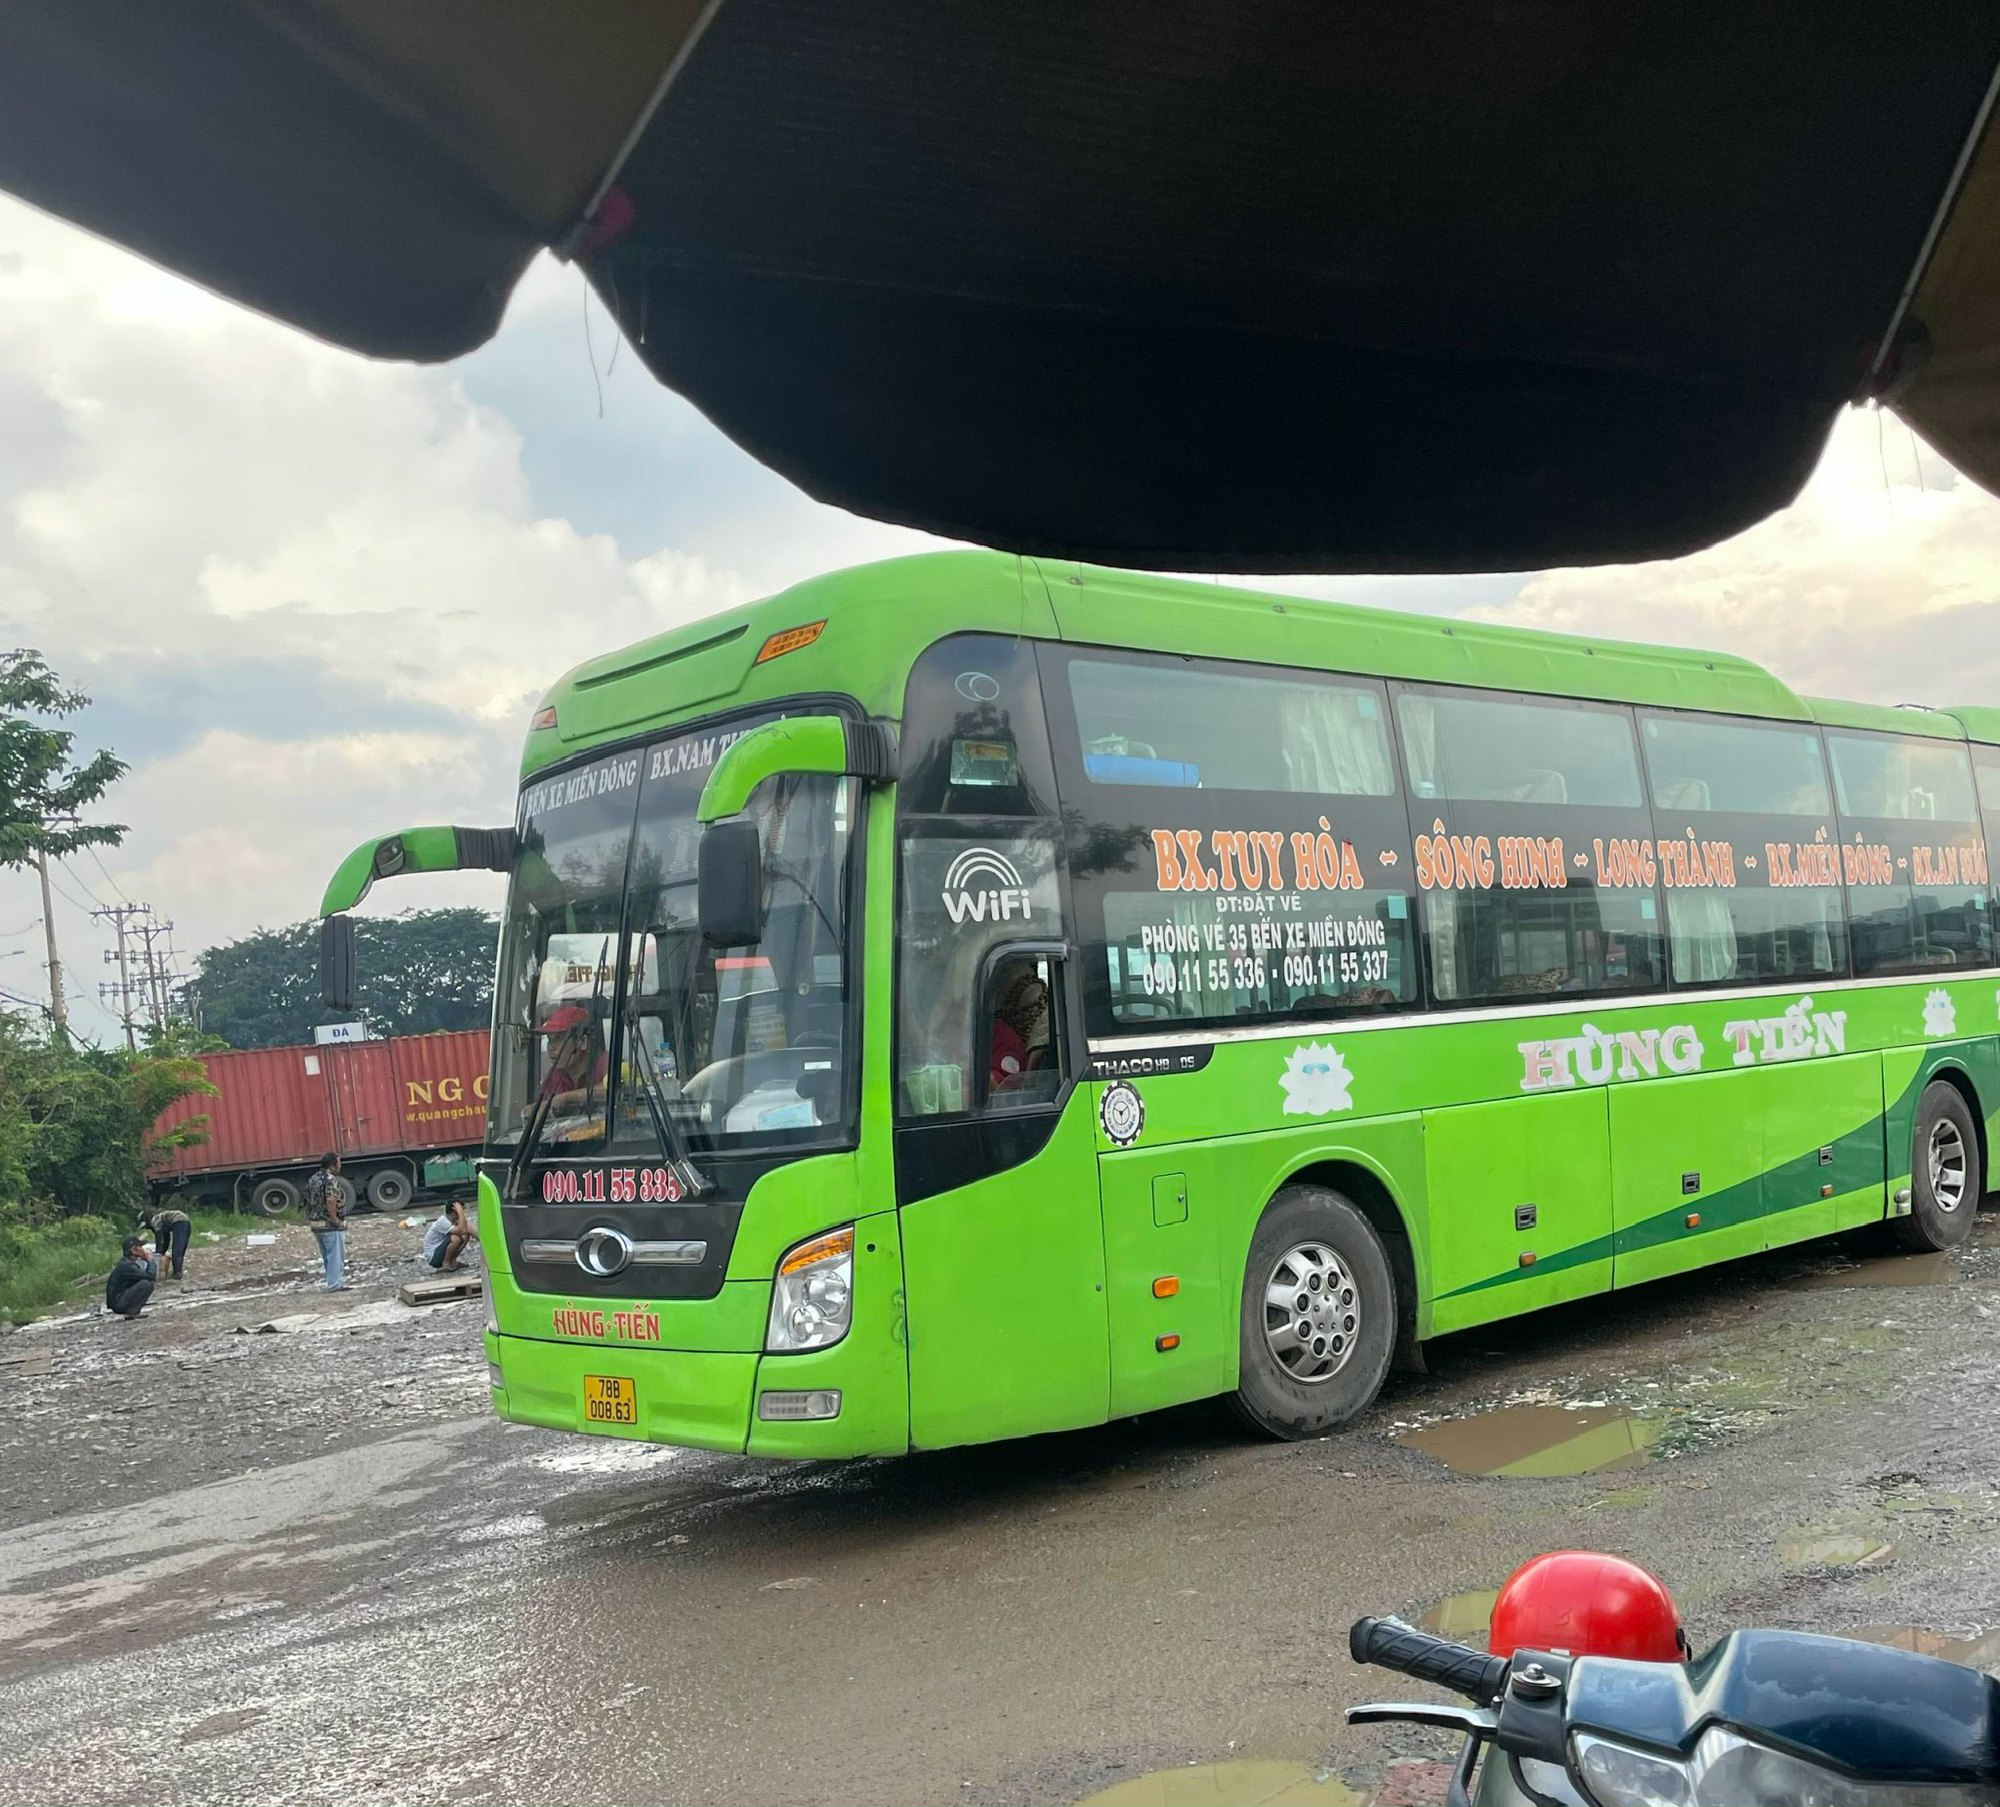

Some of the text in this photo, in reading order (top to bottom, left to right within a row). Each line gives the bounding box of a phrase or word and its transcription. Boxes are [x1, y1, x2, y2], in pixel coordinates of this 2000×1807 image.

[650, 737, 716, 780] BX.NAM
[547, 782, 565, 811] XE
[598, 760, 637, 795] ĐÔNG
[1151, 829, 1284, 891] BX.TUY
[1290, 815, 1364, 889] HÒA
[1415, 817, 1495, 890] SÔNG
[1497, 836, 1567, 889] HINH
[1593, 838, 1656, 888] LONG
[1657, 826, 1736, 888] THÀNH
[1765, 825, 1842, 887] BX.MIỀN
[1842, 831, 1893, 886] ĐÔNG
[1912, 846, 1960, 885] BX.AN
[941, 889, 1031, 923] WiFi
[1216, 891, 1302, 916] ĐT:ĐẶT VÉ
[1141, 914, 1385, 954] PHÒNG VÉ 35 BẾN XE MIỀN ĐÔNG
[1143, 959, 1202, 996] 090.11
[1208, 958, 1230, 991] 55
[1233, 956, 1265, 990] 336
[1283, 953, 1335, 987] 090.11
[1340, 952, 1359, 983] 55
[1362, 950, 1388, 981] 337
[1518, 996, 1847, 1091] HÙNG TIẾN
[1093, 1058, 1153, 1075] THACO
[1155, 1059, 1170, 1071] HB
[542, 1168, 682, 1203] 090.11 55 335
[553, 1300, 660, 1342] HÙNG TIẾN
[598, 1379, 620, 1398] 78B
[591, 1400, 630, 1420] 008.63
